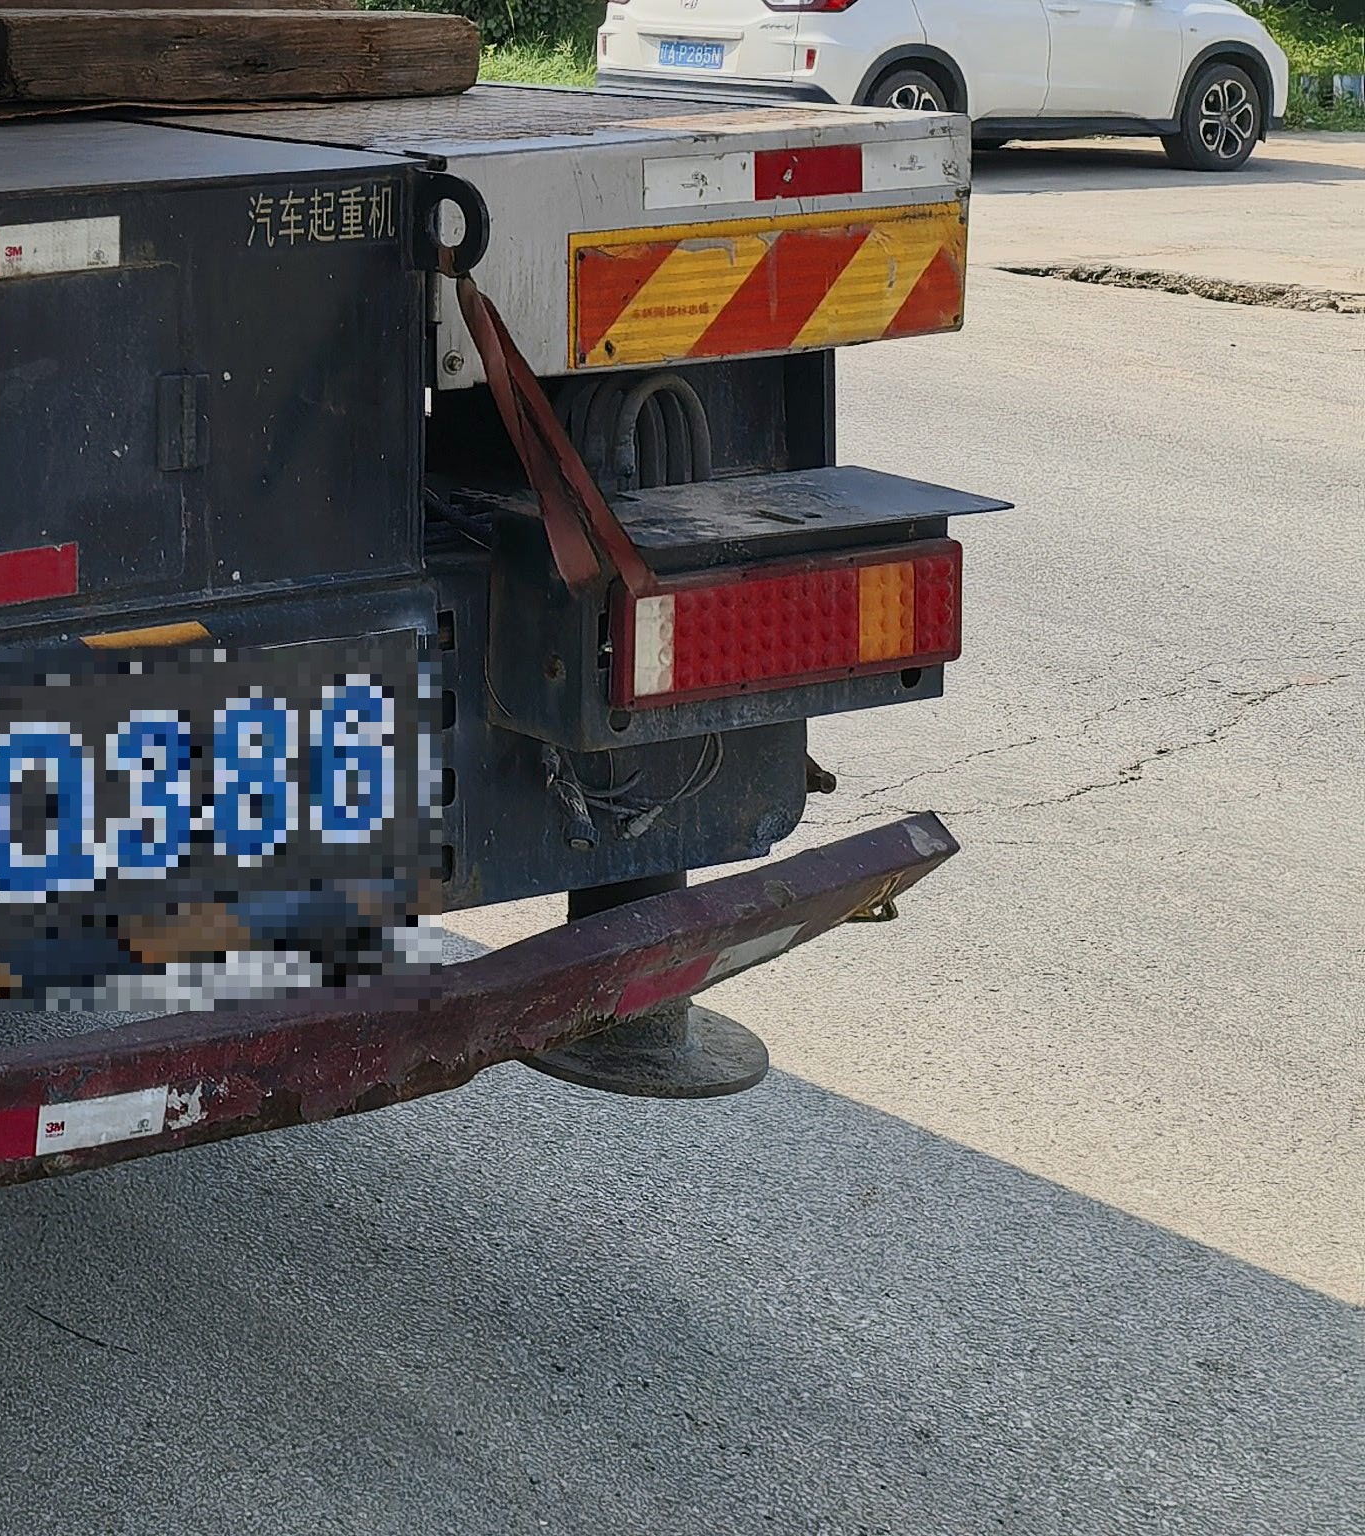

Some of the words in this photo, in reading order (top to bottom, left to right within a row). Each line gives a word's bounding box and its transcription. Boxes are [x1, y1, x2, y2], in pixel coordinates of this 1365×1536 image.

[247, 184, 395, 248] 汽车起重机
[4, 245, 23, 257] 3M
[45, 1120, 66, 1134] 3M
